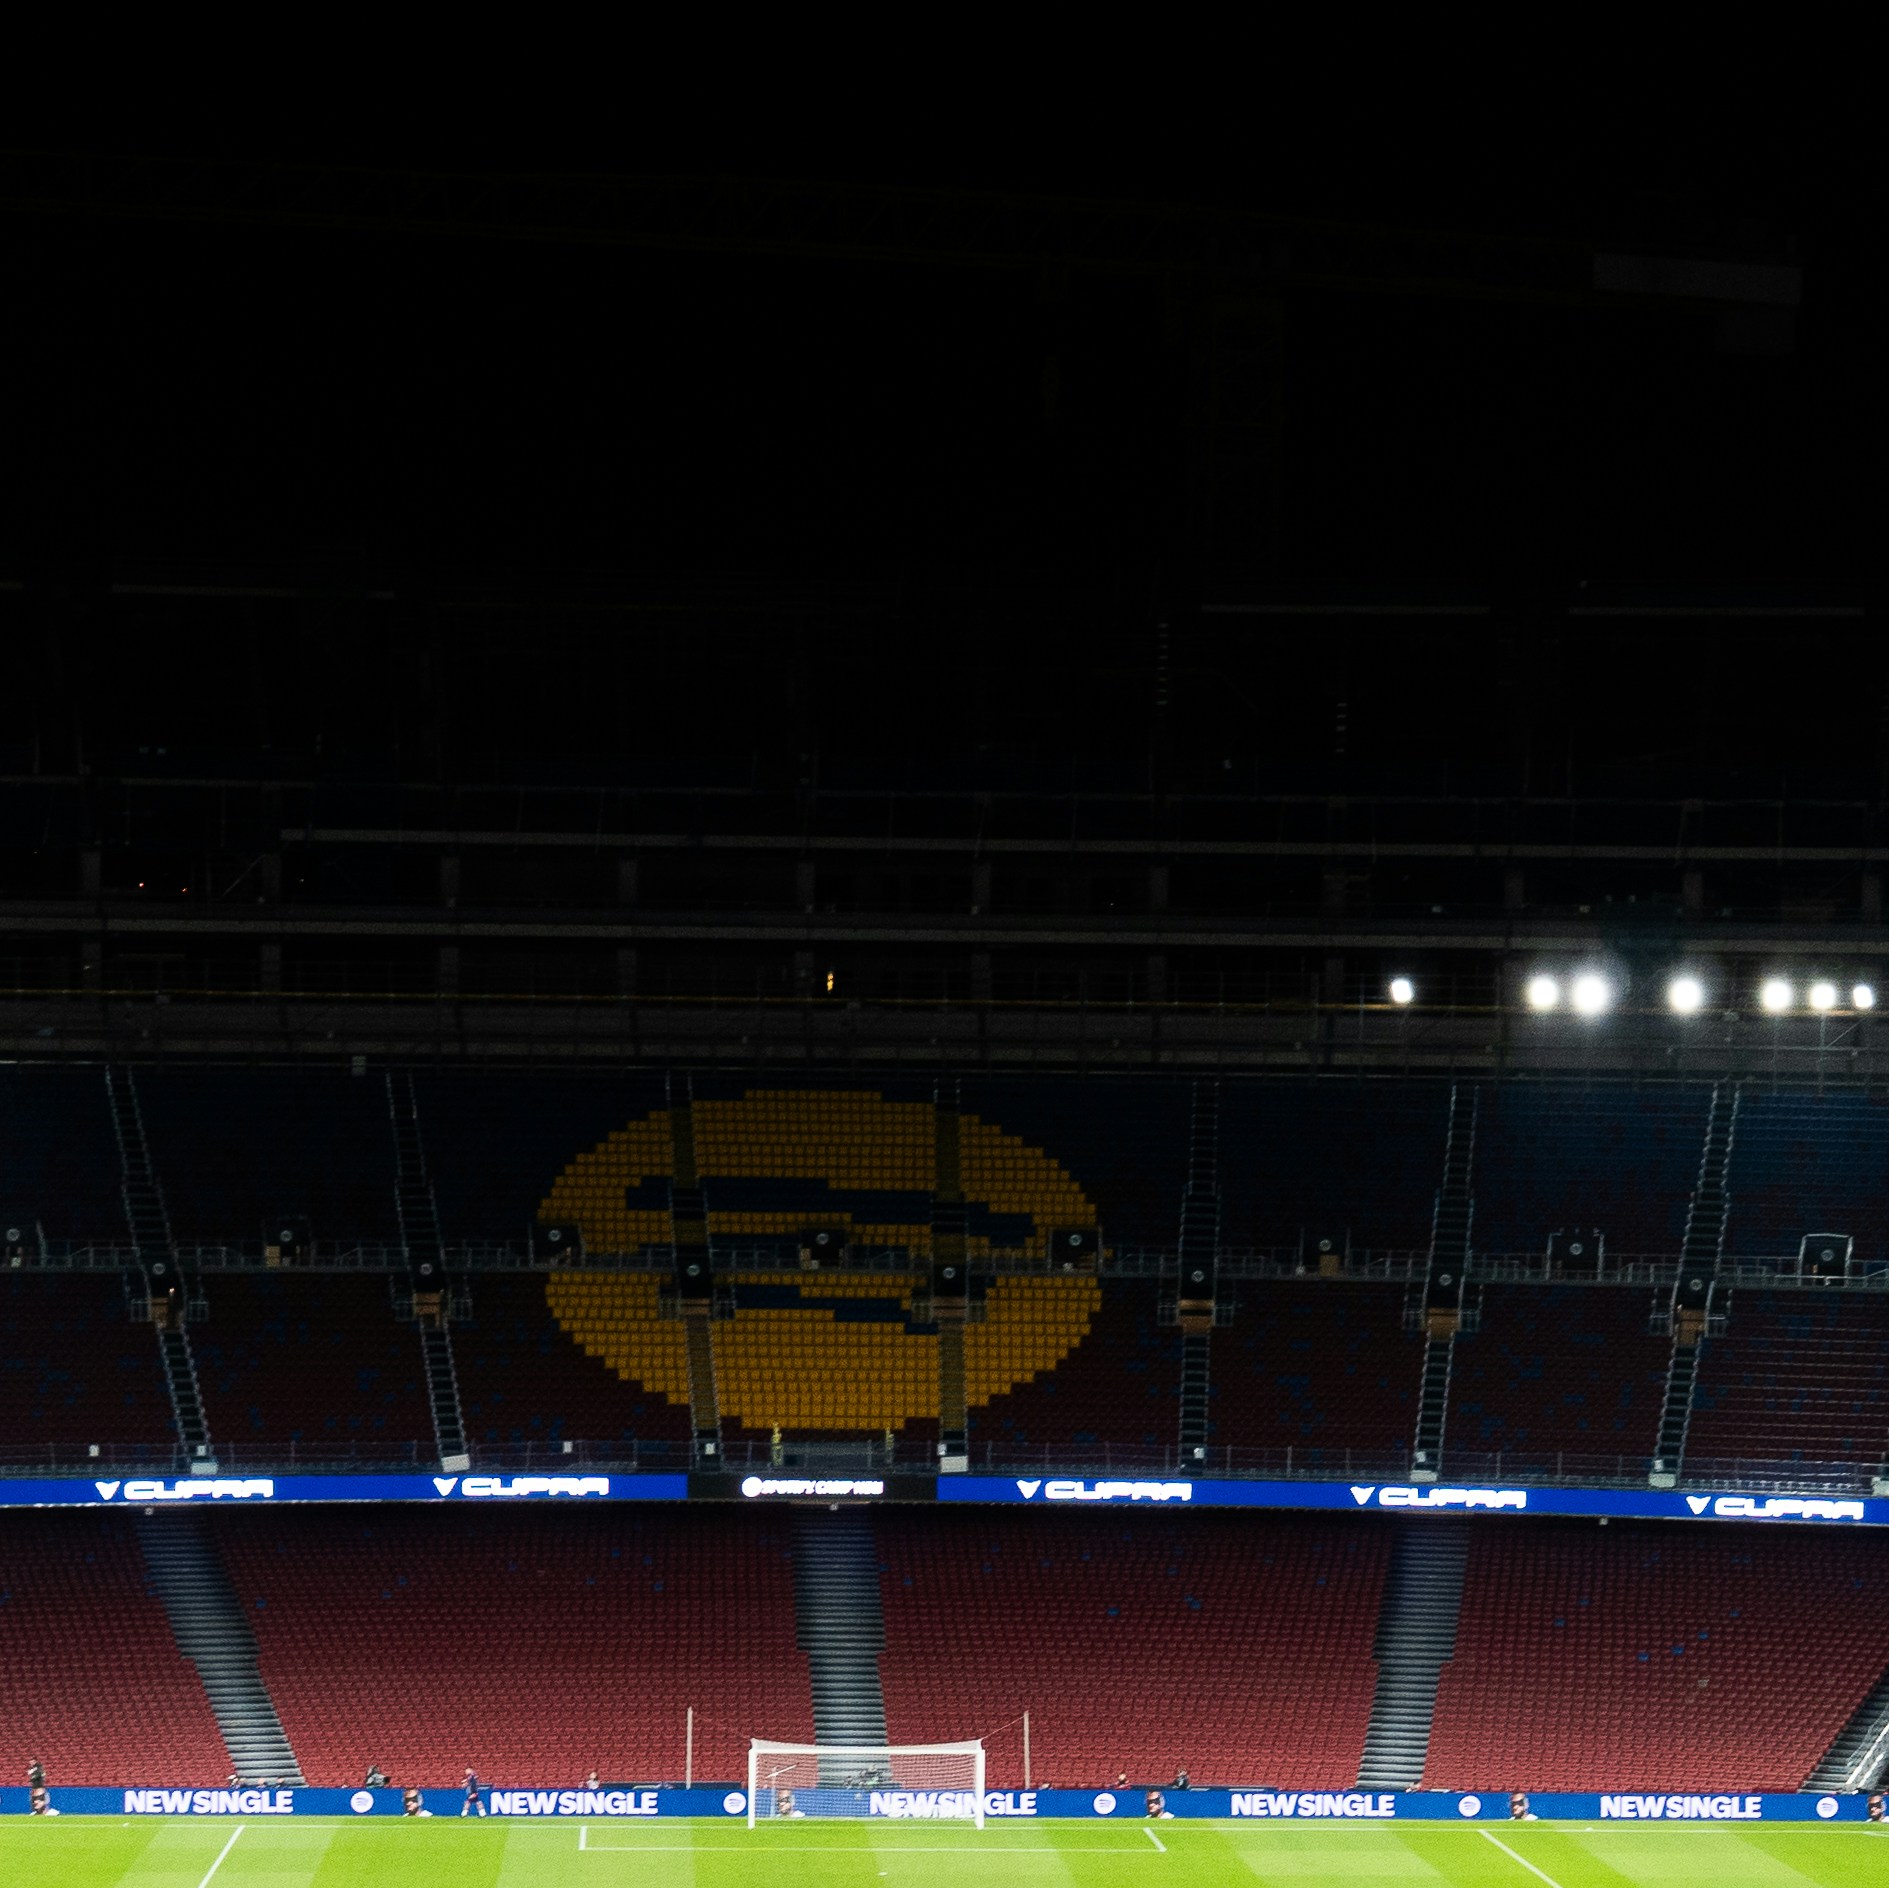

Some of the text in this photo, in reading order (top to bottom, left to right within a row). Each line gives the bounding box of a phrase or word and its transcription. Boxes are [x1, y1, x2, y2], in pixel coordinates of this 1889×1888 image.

[124, 1480, 273, 1499] CUPRA
[462, 1478, 609, 1496] CUPRA
[1045, 1481, 1192, 1500] CUPRA
[1379, 1488, 1526, 1508] CUPRA
[1715, 1498, 1864, 1519] CUPRA
[124, 1790, 293, 1814] NEW SINGLE
[490, 1792, 658, 1815] NEW SINGLE
[1230, 1794, 1395, 1817] NEW SINGLE
[1599, 1795, 1762, 1818] NEW SINGLE
